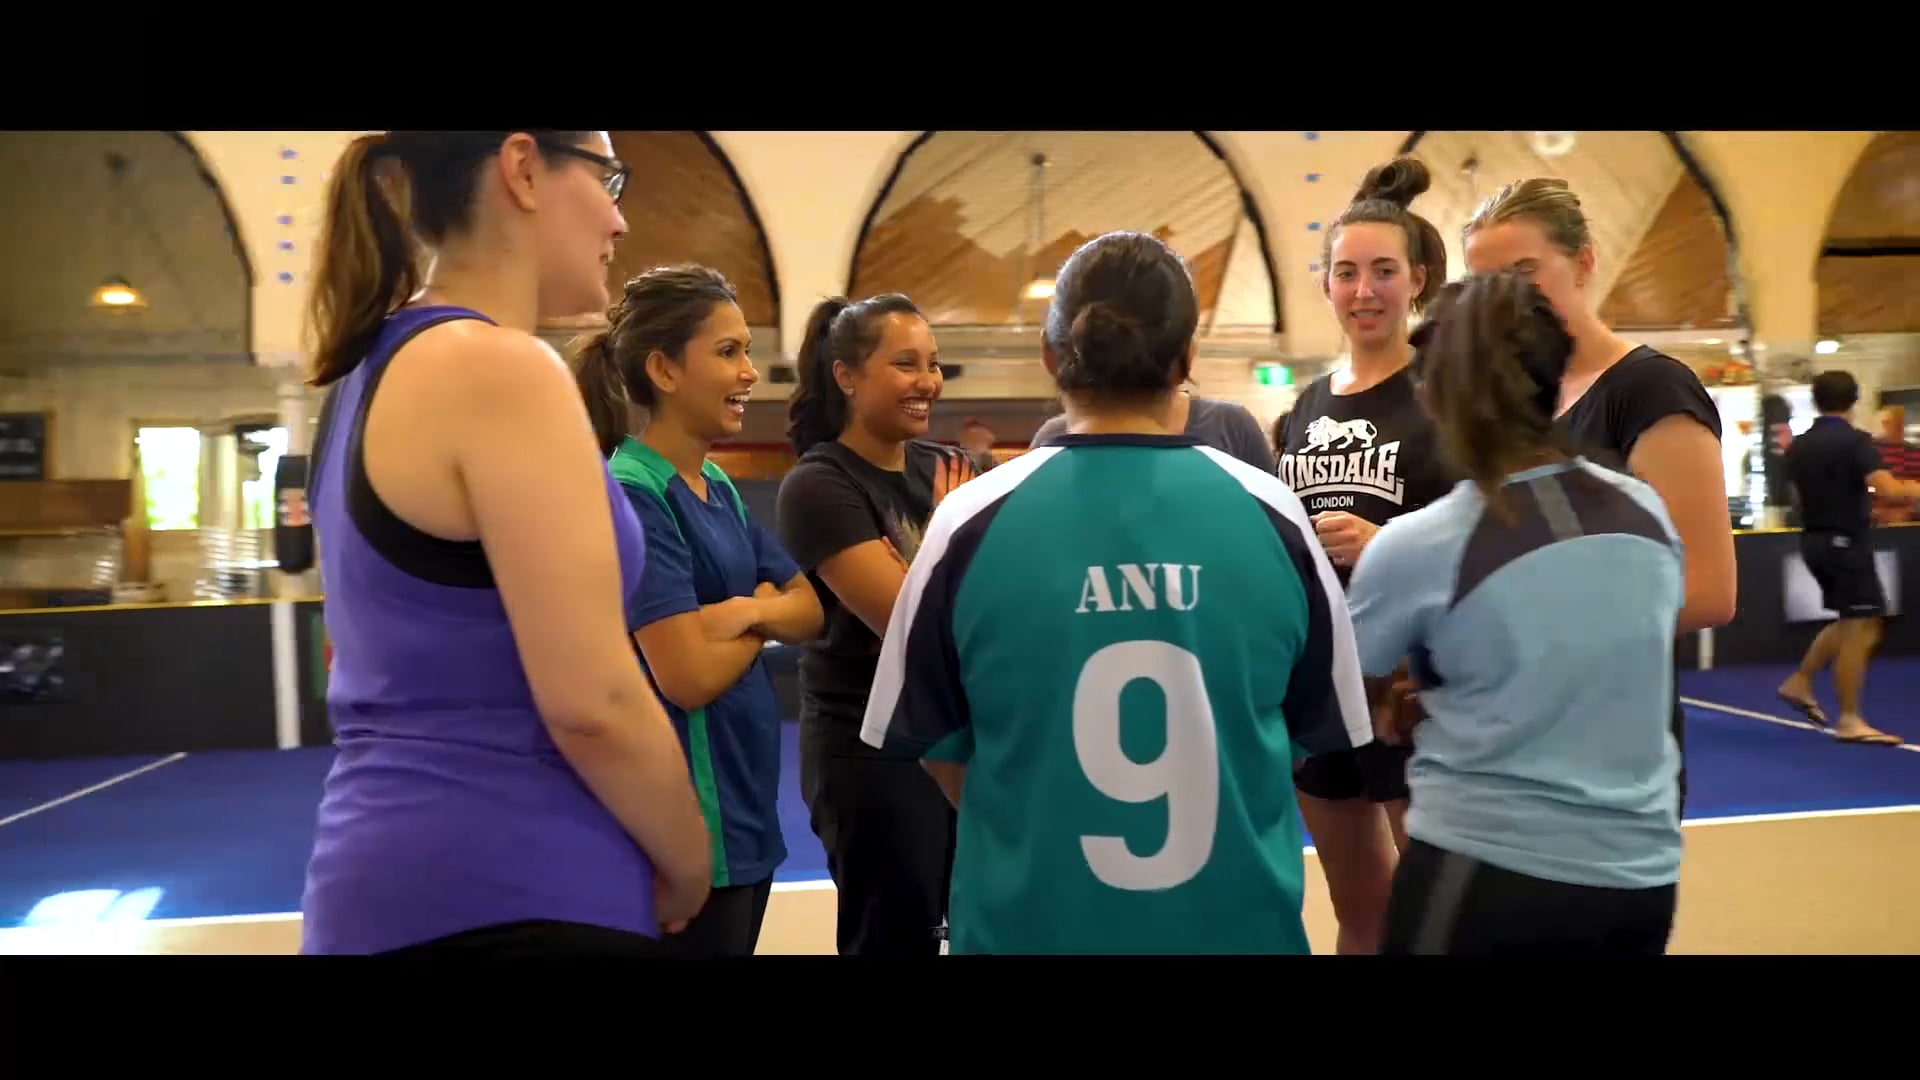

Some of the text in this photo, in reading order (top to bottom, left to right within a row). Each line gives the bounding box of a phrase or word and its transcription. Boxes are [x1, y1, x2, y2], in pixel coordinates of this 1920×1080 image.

[1278, 440, 1401, 494] ONSDALE
[1311, 496, 1354, 509] LONDON
[1075, 563, 1203, 613] ANU
[1072, 639, 1220, 892] 9
